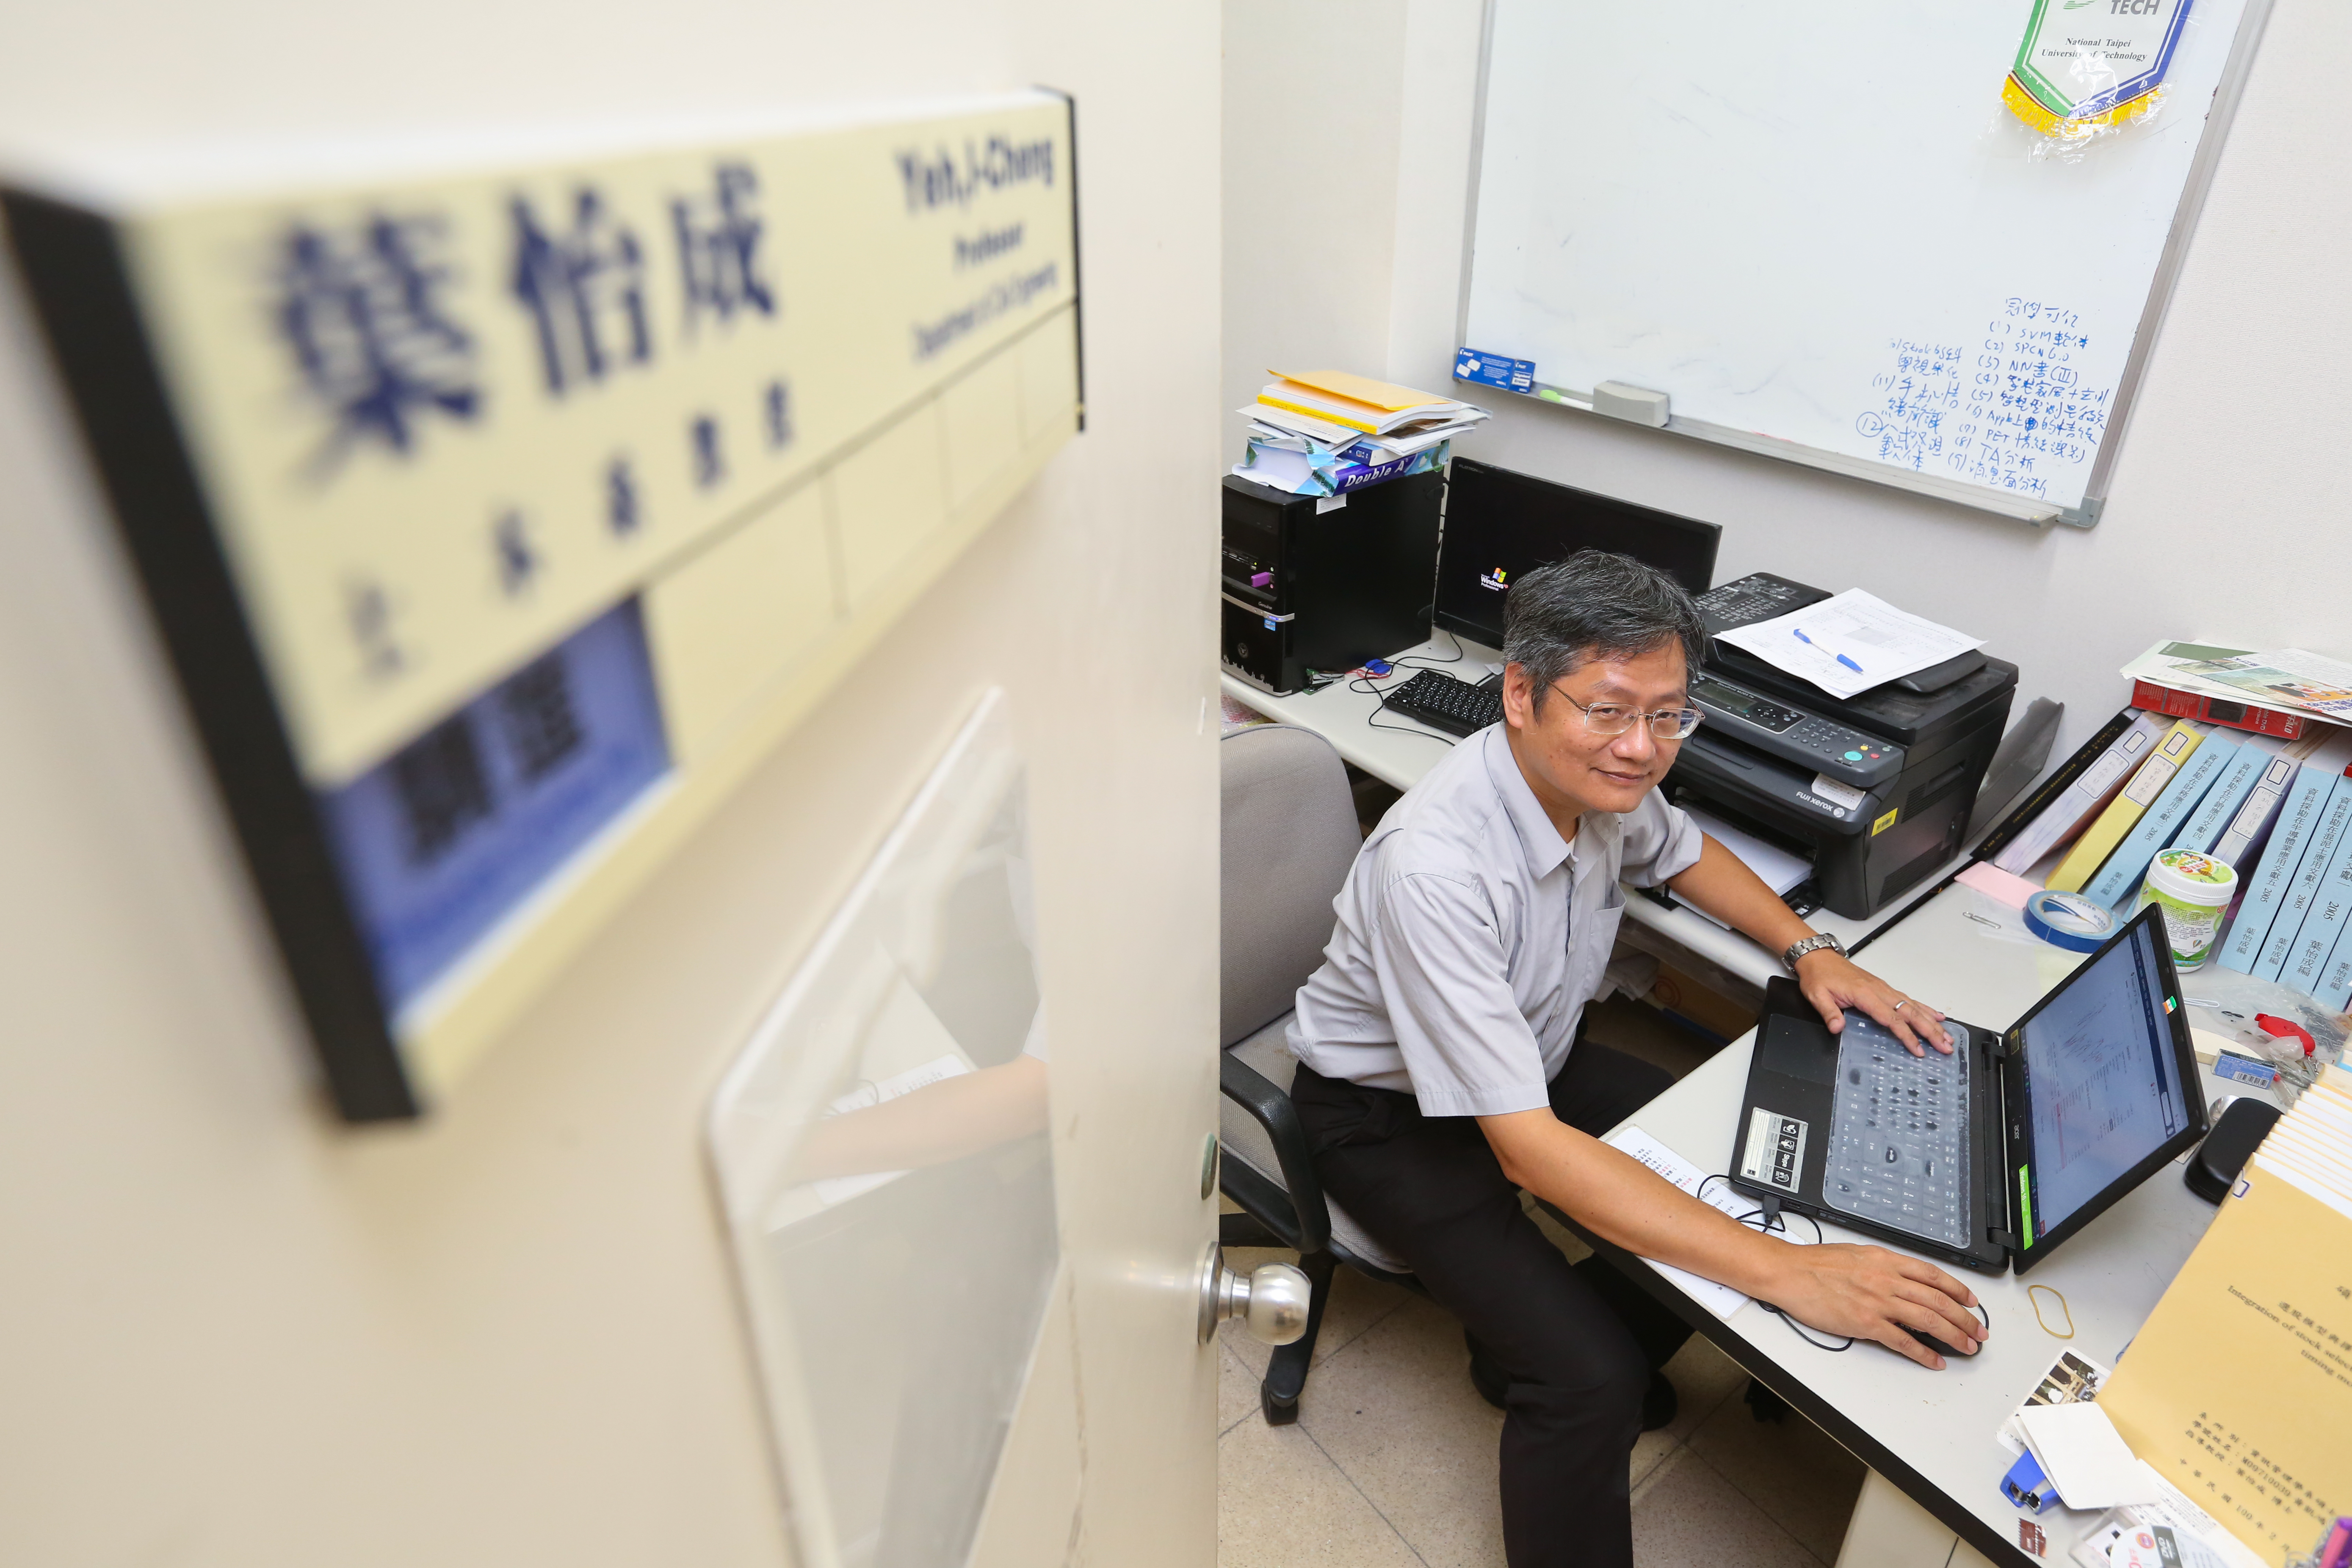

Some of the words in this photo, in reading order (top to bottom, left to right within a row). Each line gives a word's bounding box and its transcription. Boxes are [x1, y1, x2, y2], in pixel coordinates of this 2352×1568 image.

[2109, 0, 2160, 15] TECH
[2065, 37, 2100, 47] National
[2105, 38, 2131, 49] Taipei
[2041, 49, 2083, 61] University
[2088, 50, 2098, 58] of
[2101, 51, 2147, 62] Technology
[271, 161, 781, 461] 葉怡成
[1344, 466, 1392, 487] Double
[1395, 460, 1405, 473] A
[1481, 576, 1504, 589] Windows
[1796, 791, 1810, 802] FUJI
[2145, 827, 2158, 841] 2005
[2261, 887, 2272, 903] 2005
[2294, 894, 2306, 910] 2005
[2323, 901, 2339, 921] 2005
[2236, 927, 2256, 955] 葉怡成編
[2268, 936, 2288, 966] 葉怡成編
[2296, 939, 2323, 977] 葉怡成編
[2329, 961, 2351, 991] 葉怡成編
[1781, 1154, 1790, 1167] Skype
[2228, 1285, 2279, 1322] Integration
[2282, 1322, 2295, 1331] of
[2294, 1331, 2321, 1350] stock
[2301, 1350, 2335, 1376] timing
